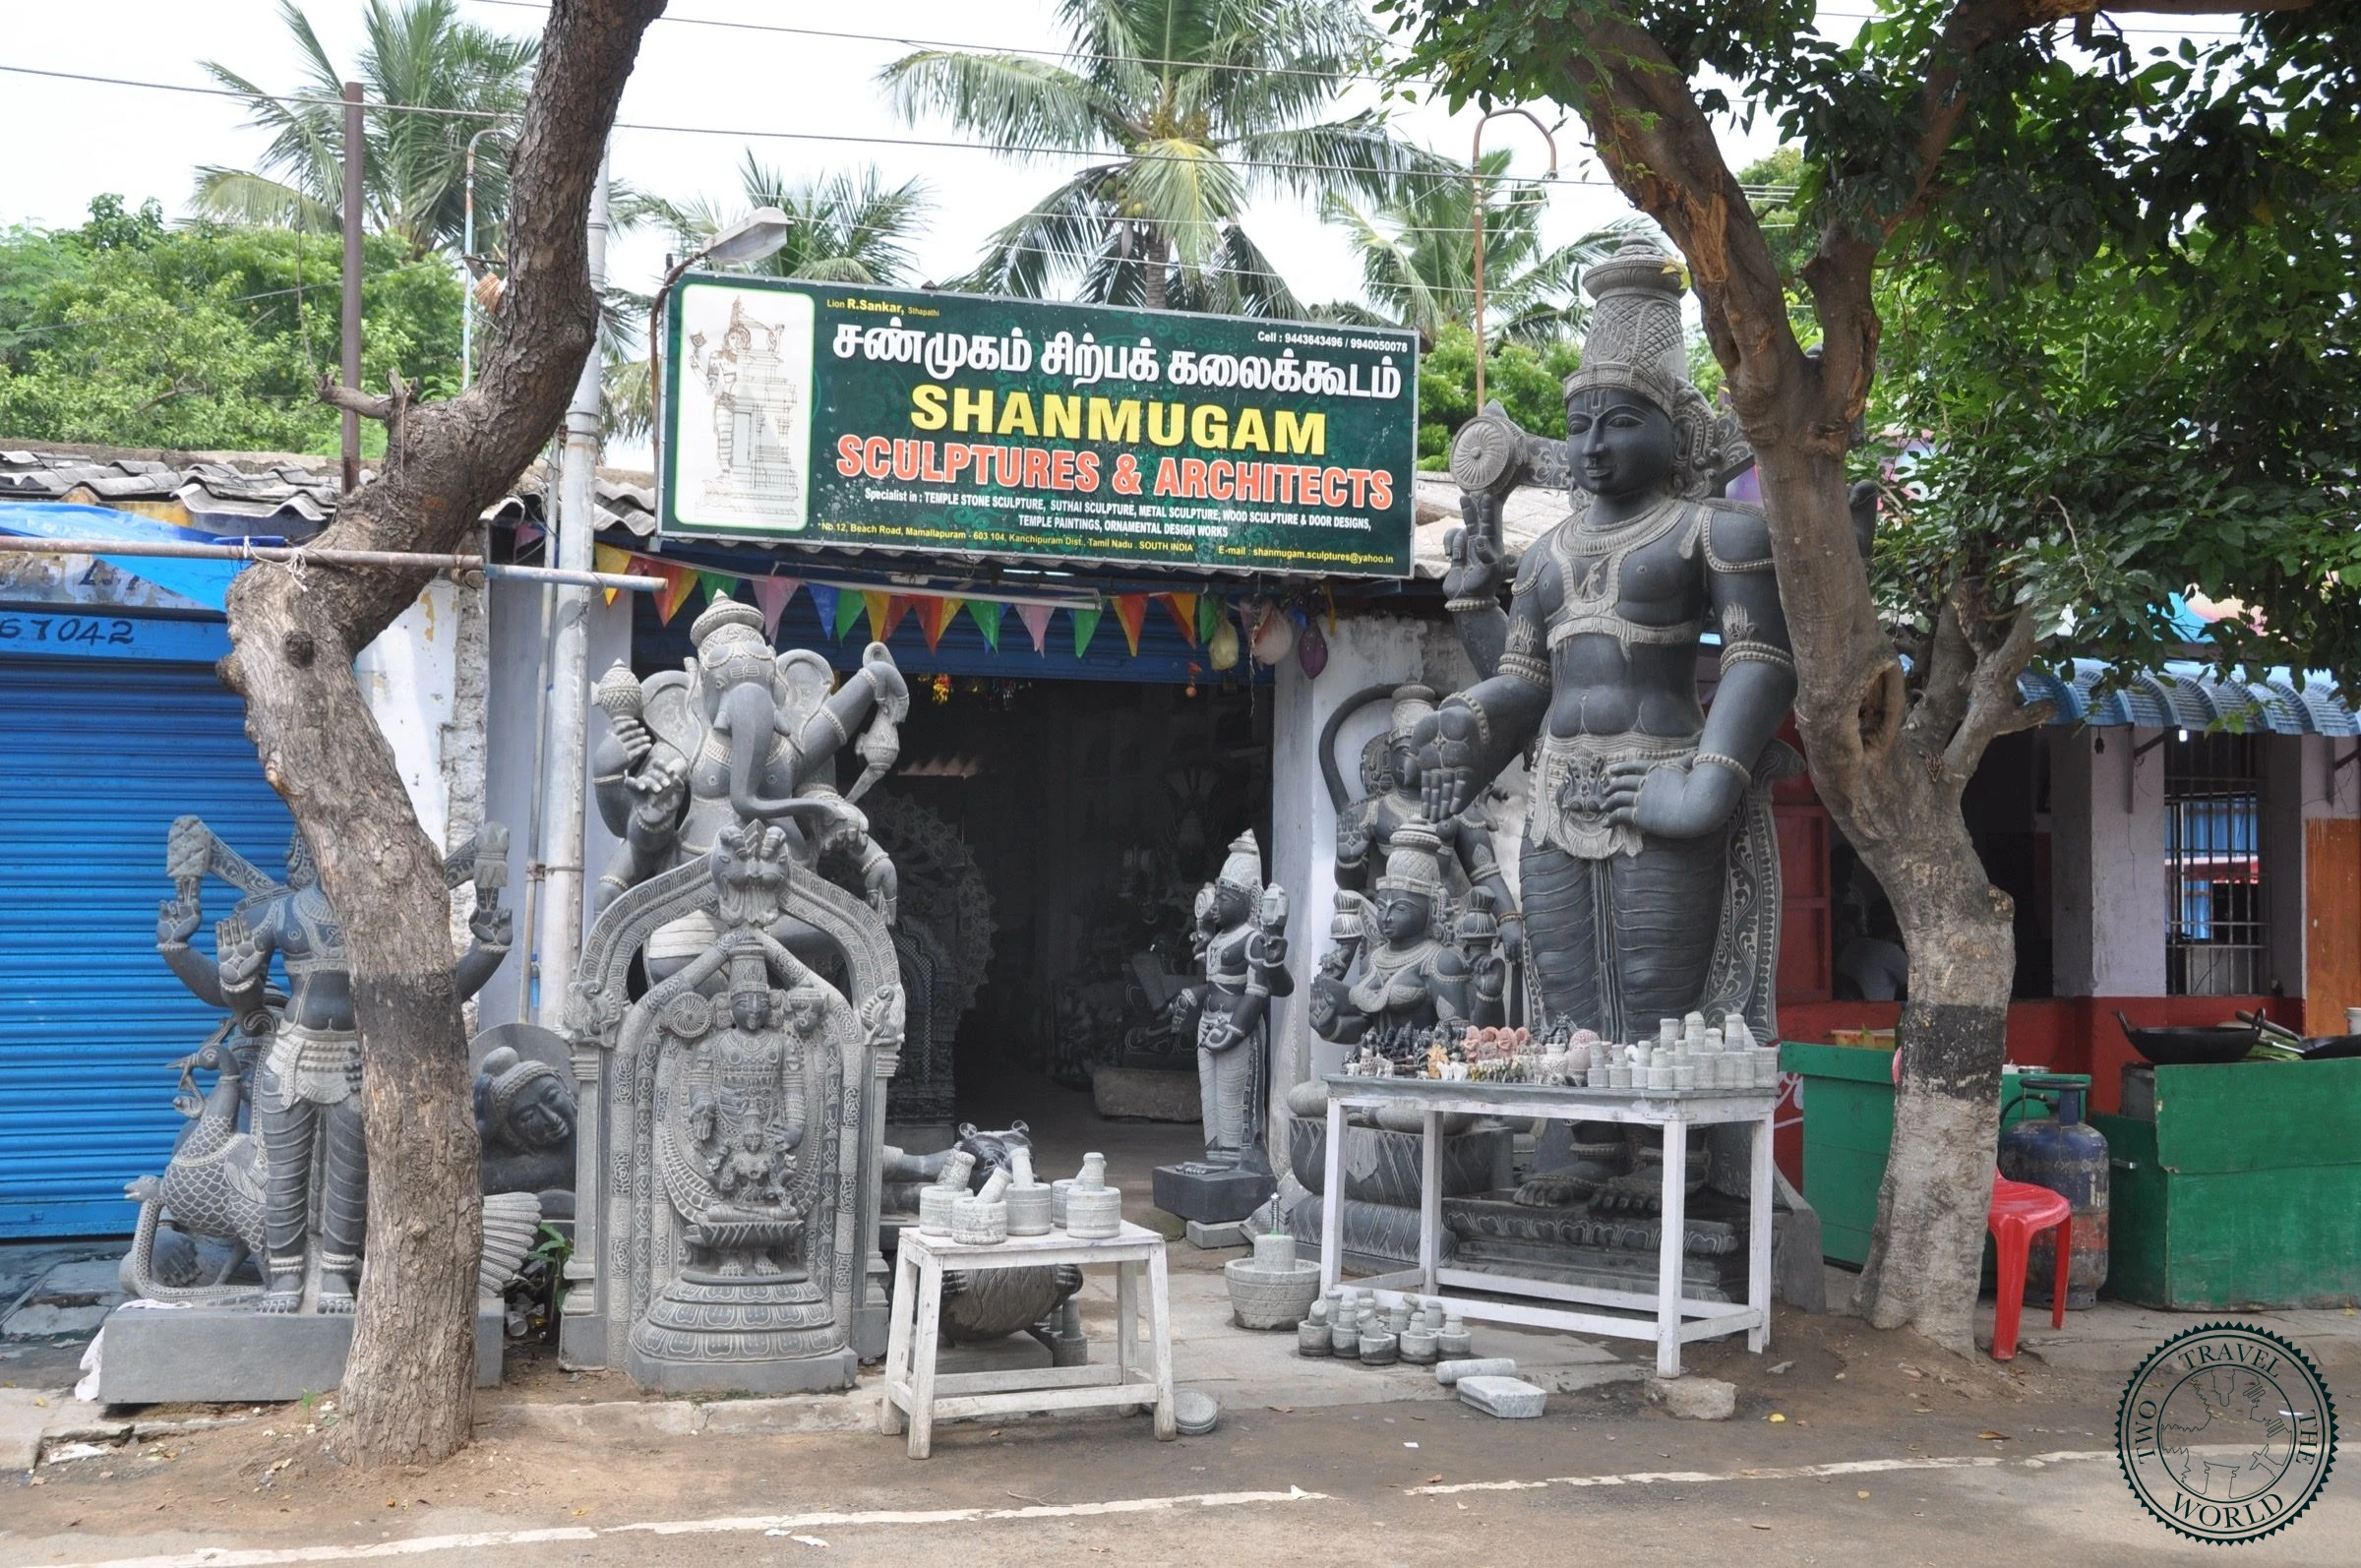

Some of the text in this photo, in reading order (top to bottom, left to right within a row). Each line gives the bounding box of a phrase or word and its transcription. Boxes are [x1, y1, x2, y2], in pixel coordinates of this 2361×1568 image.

[826, 298, 939, 317] Lion R.Sankar, Sthapathi
[1257, 331, 1276, 342] Cell
[1285, 332, 1343, 347] 9443643496
[1351, 338, 1408, 353] 9940050078
[832, 316, 1402, 399] சண்முகம் சிற்பக் கலைக்கூடம்
[910, 385, 1326, 455] SHANMUGAM
[836, 434, 1393, 511] SCULPTURES & ARCHITECTS
[865, 488, 907, 502] Specialist
[909, 491, 917, 502] in
[924, 492, 959, 506] TEMPLE
[961, 495, 991, 508] STONE
[992, 496, 1046, 512] SCULPTURE,
[1050, 500, 1082, 512] SUTHAI
[1084, 502, 1137, 516] SCULPTURE,
[1138, 505, 1166, 517] METAL
[1169, 507, 1221, 522] SCULPTURE,
[1223, 511, 1247, 522] WOOD
[1249, 513, 1299, 525] SCULPTURE
[1301, 514, 1307, 525] &
[1308, 514, 1332, 527] DOOR
[1333, 516, 1371, 532] DESIGNS,
[850, 523, 877, 533] Beach
[879, 525, 904, 536] Road,
[905, 527, 966, 540] Mamallapuram
[1009, 533, 1062, 545] Kanchipuram
[1112, 539, 1132, 548] Nadu
[1139, 541, 1168, 551] SOUTH
[1170, 542, 1193, 552] INDIA
[1018, 514, 1228, 538] TEMPLE PAINTINGS, ORNAMENTAL DESIGN WORKS
[1218, 545, 1245, 556] E-mail
[1252, 547, 1394, 565] shanmugam.sculptures@yahoo.in
